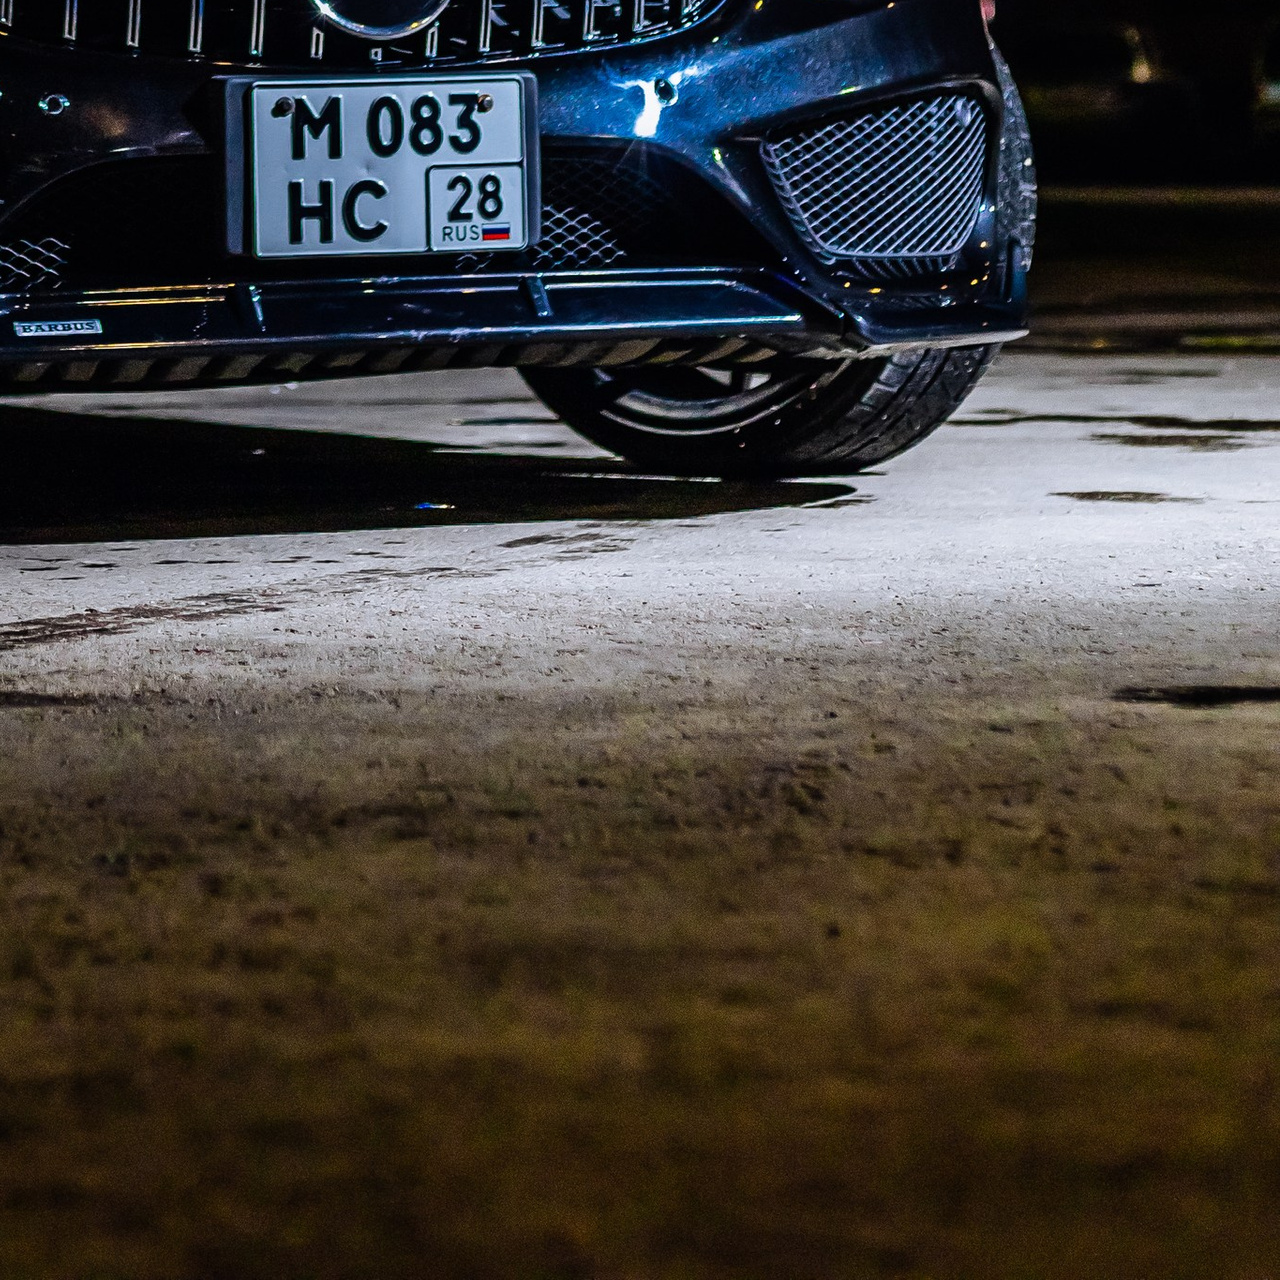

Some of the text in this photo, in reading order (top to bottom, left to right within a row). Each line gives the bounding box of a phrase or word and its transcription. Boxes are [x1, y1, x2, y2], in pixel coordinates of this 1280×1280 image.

[367, 91, 482, 158] 083
[447, 173, 504, 223] 28
[442, 224, 480, 242] RUS
